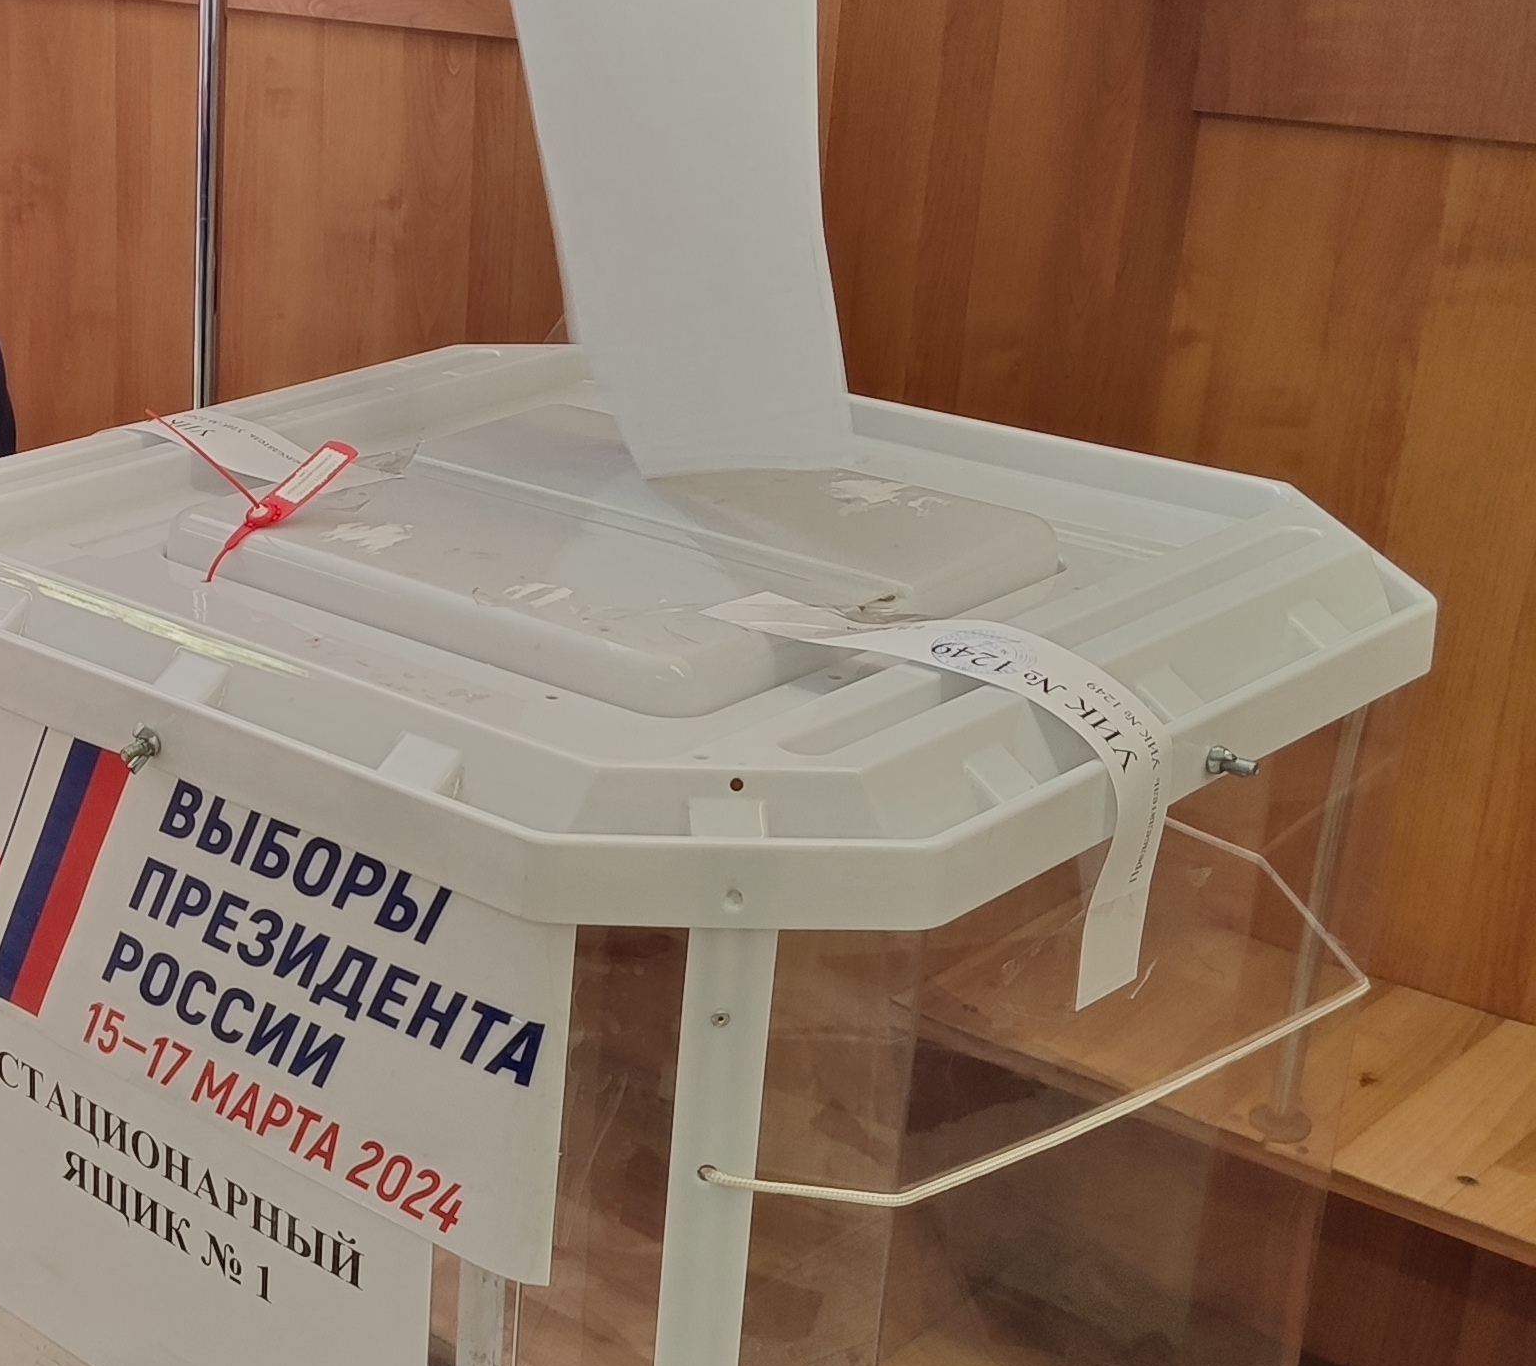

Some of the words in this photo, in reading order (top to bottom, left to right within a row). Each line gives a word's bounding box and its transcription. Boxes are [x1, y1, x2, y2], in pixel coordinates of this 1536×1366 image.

[931, 640, 1008, 676] 1249
[1024, 669, 1068, 697] №
[1065, 695, 1139, 774] УИК
[1085, 680, 1120, 710] 1249
[158, 777, 454, 946] ВЫБОРЫ
[100, 930, 346, 1090] РОССИИ
[127, 856, 548, 1088] ПРЕЗИДЕНТА
[189, 1058, 343, 1174] МАРТА
[344, 1139, 465, 1235] 2024
[61, 1150, 193, 1258] ЯЩИК
[200, 1229, 244, 1286] №
[257, 1264, 274, 1305] 1
